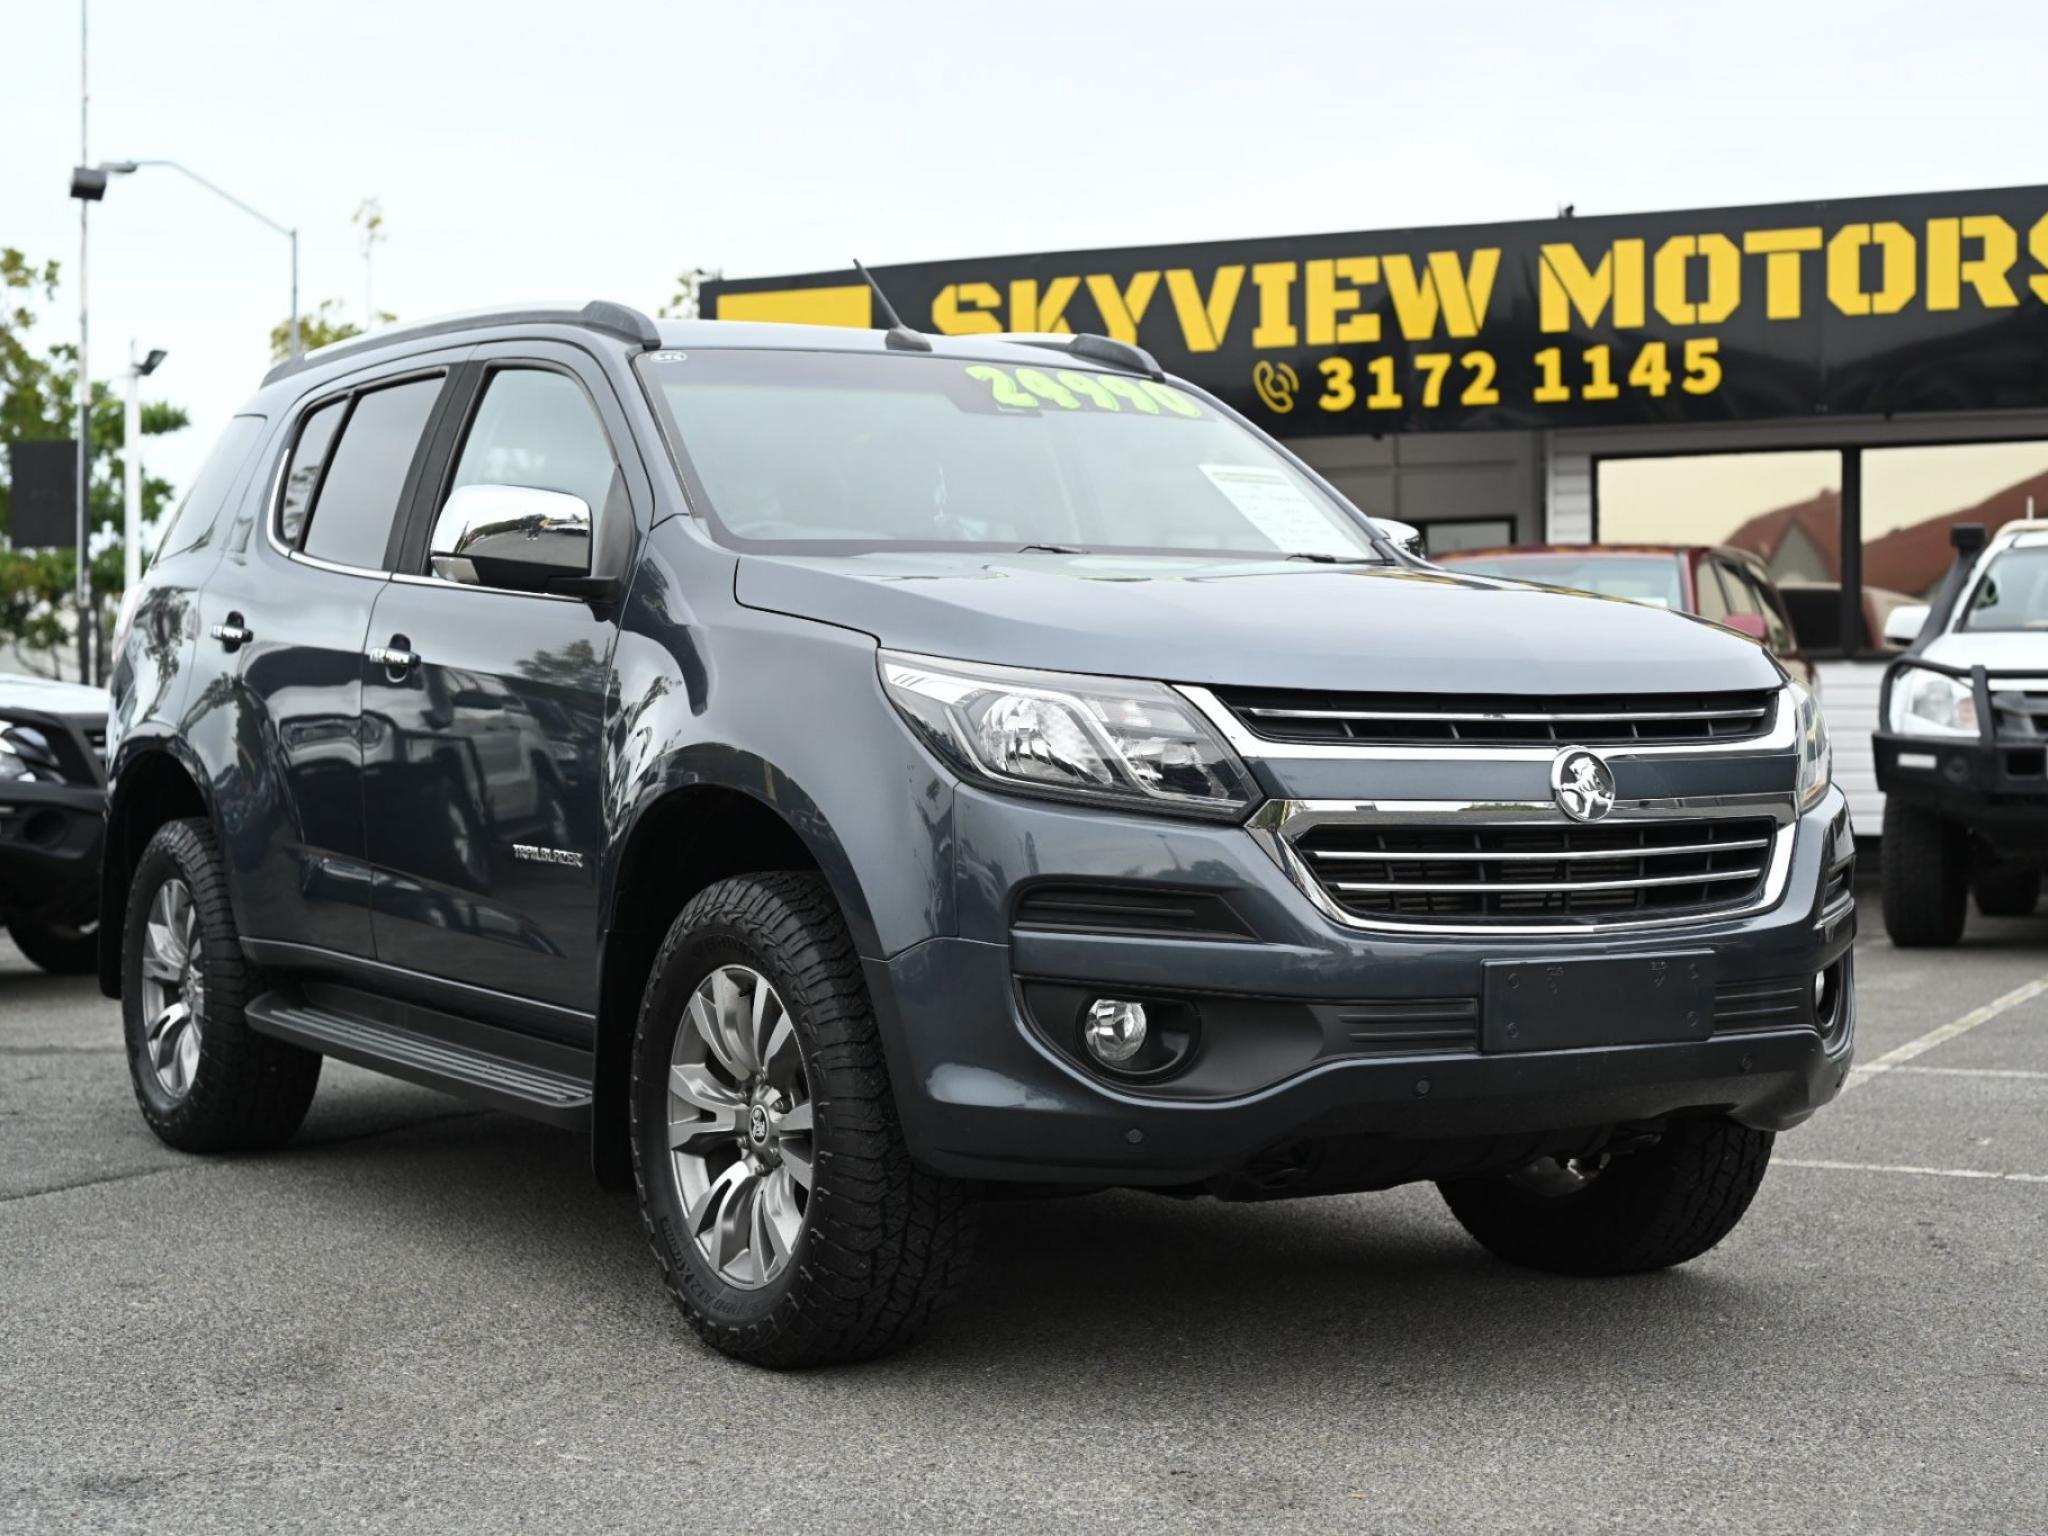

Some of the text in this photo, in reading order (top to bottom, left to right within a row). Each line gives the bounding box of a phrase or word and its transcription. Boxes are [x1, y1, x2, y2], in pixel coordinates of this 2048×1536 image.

[931, 211, 2048, 352] SKYVIEW MOTOR
[1318, 338, 1723, 412] 3172 1145
